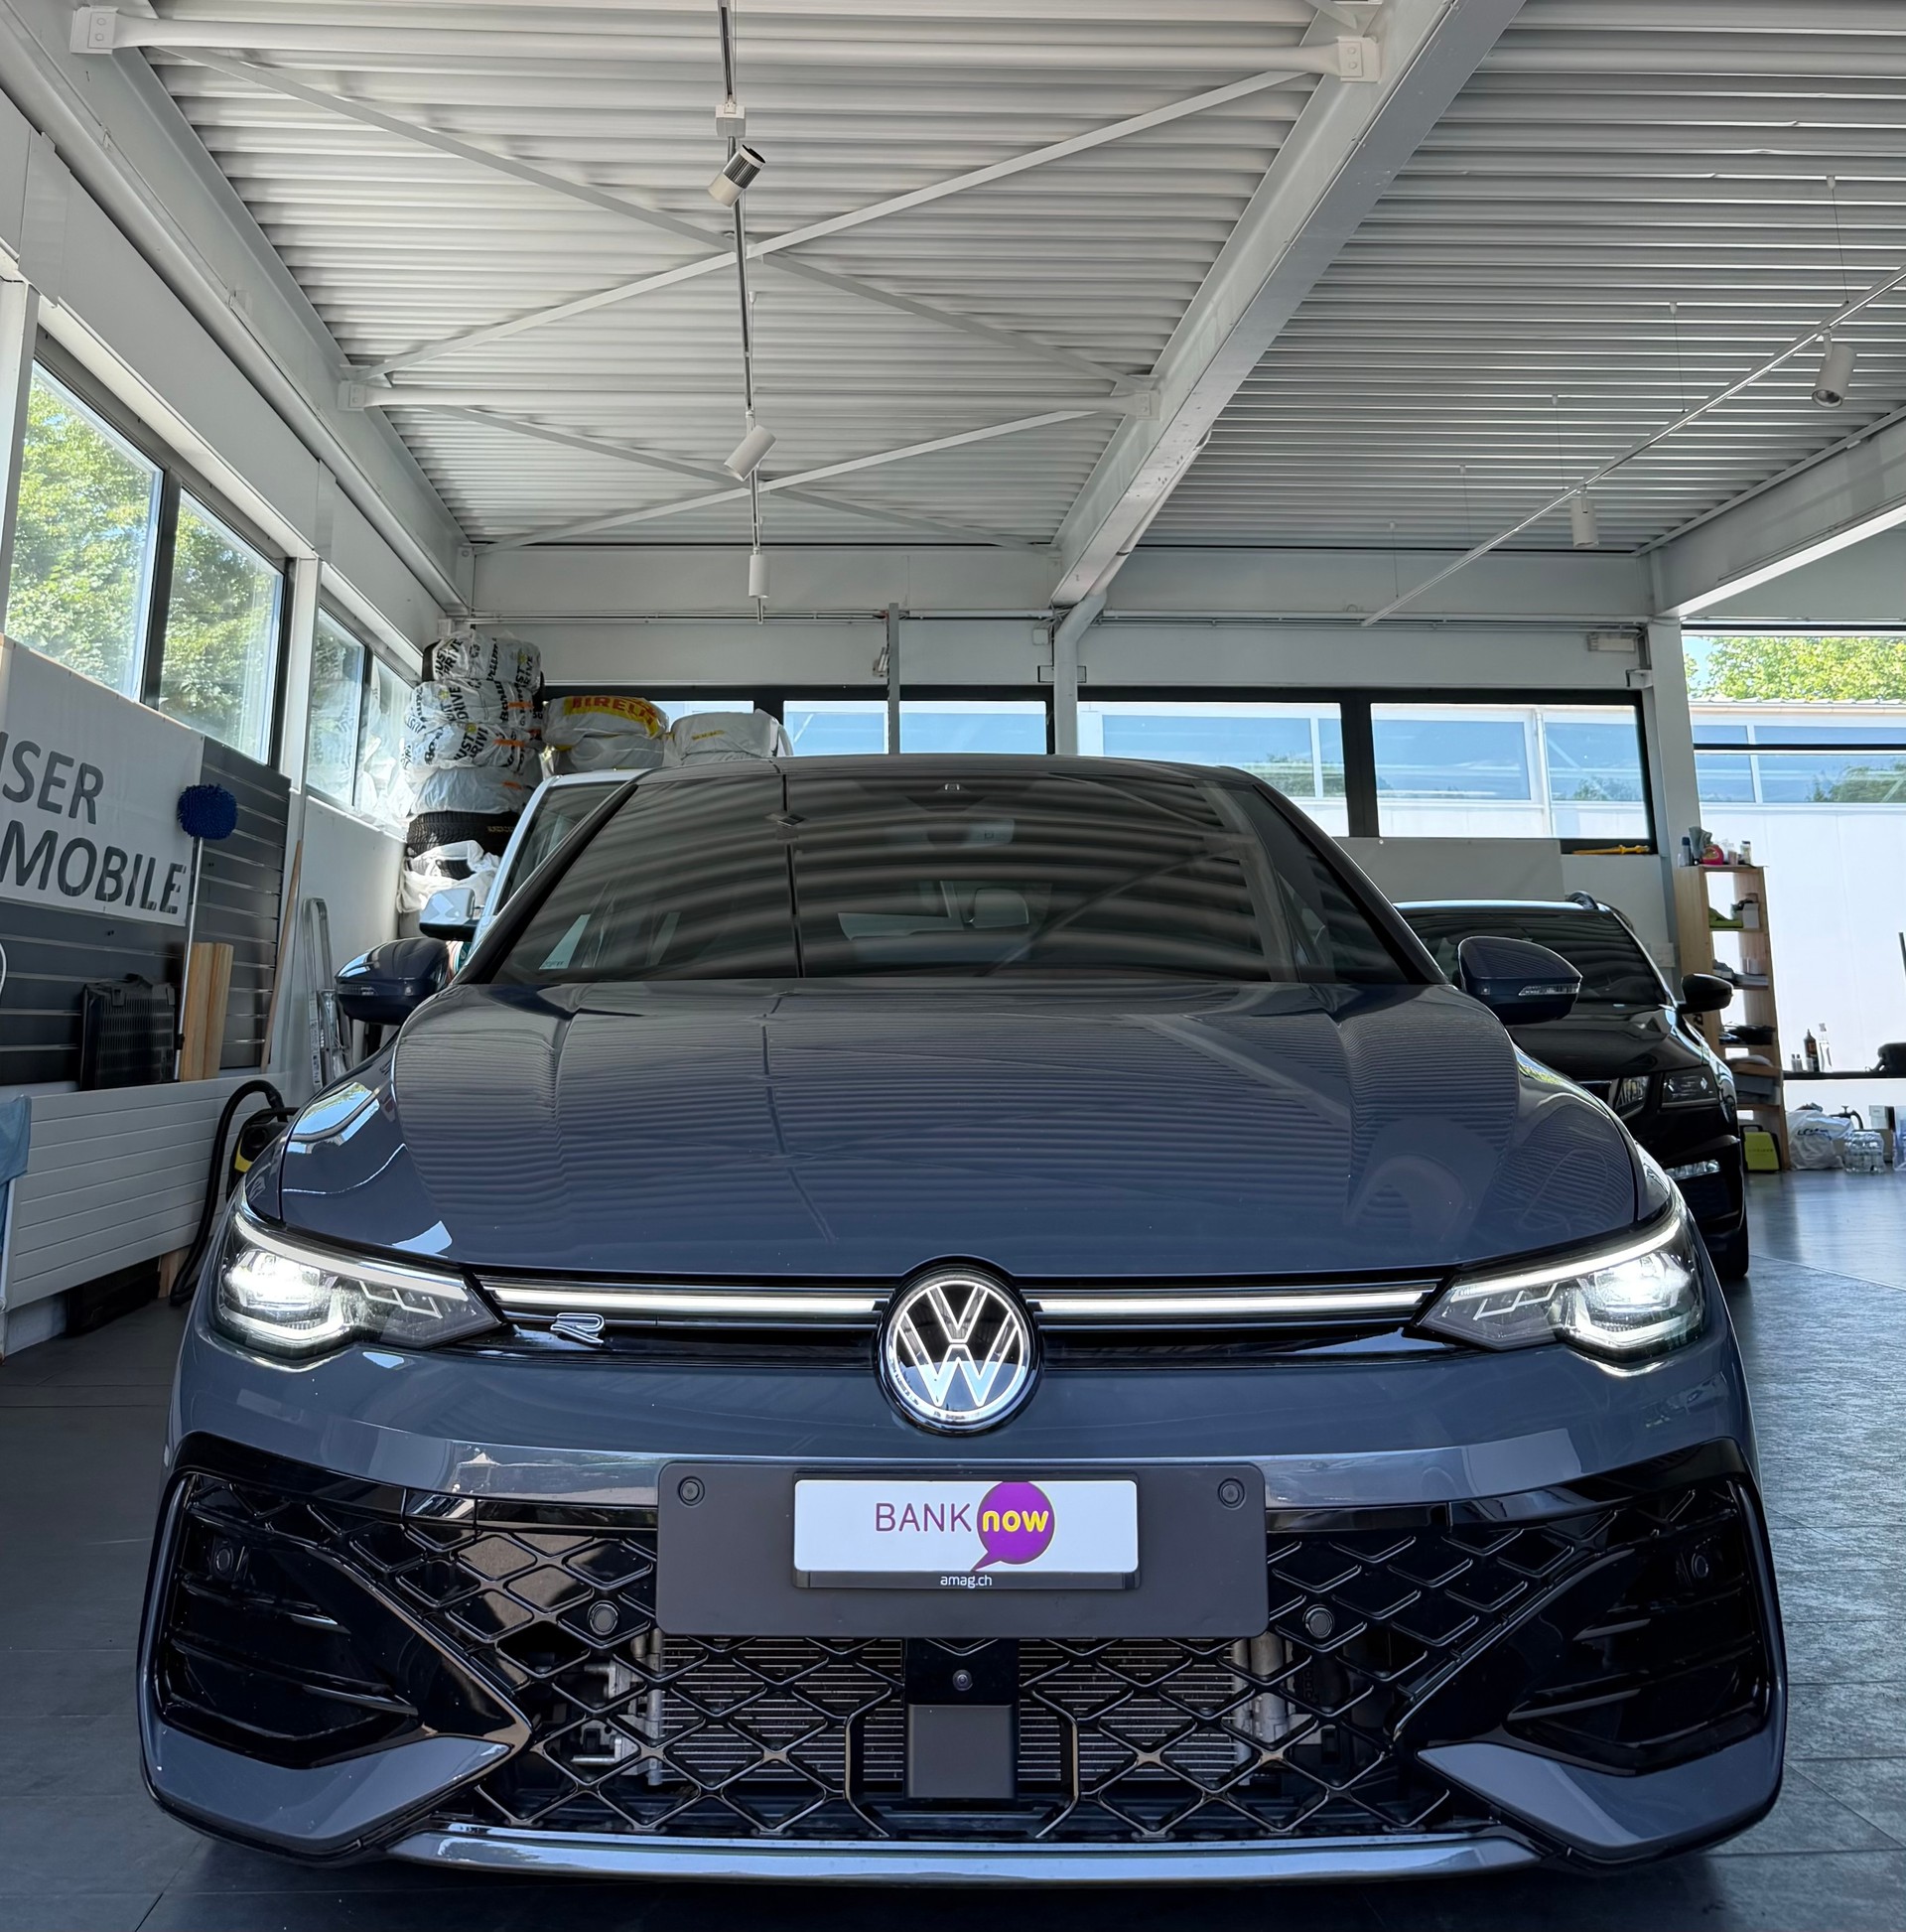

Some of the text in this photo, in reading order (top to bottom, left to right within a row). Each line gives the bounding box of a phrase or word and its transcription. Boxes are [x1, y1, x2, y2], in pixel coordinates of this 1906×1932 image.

[449, 686, 469, 721] DRIVE
[875, 1502, 1049, 1533] BANK now
[939, 1574, 993, 1588] amag.ch
